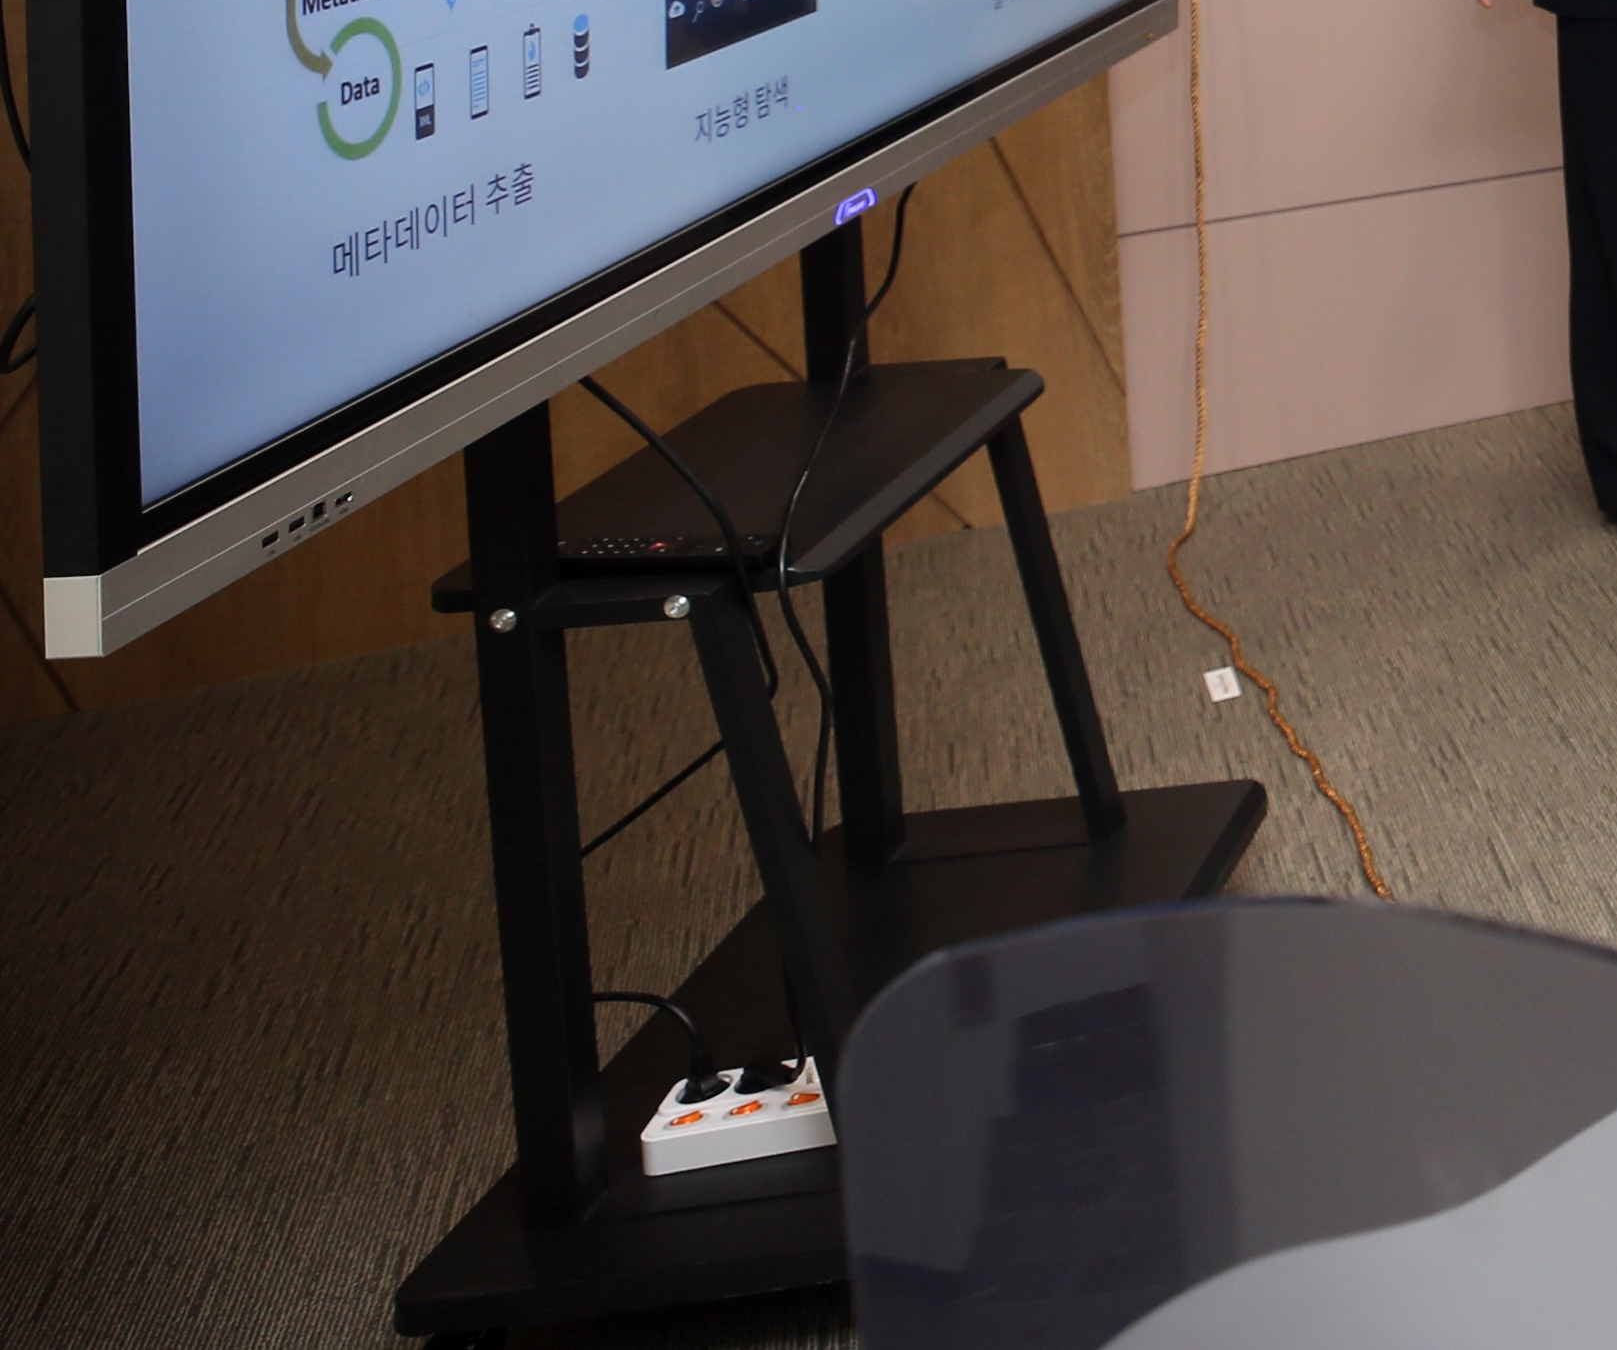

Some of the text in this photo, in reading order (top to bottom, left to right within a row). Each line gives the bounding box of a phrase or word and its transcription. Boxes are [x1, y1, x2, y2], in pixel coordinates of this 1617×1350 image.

[340, 73, 381, 106] Data
[694, 74, 790, 145] 지능형 탐색
[332, 162, 536, 278] 메타데이터 추출
